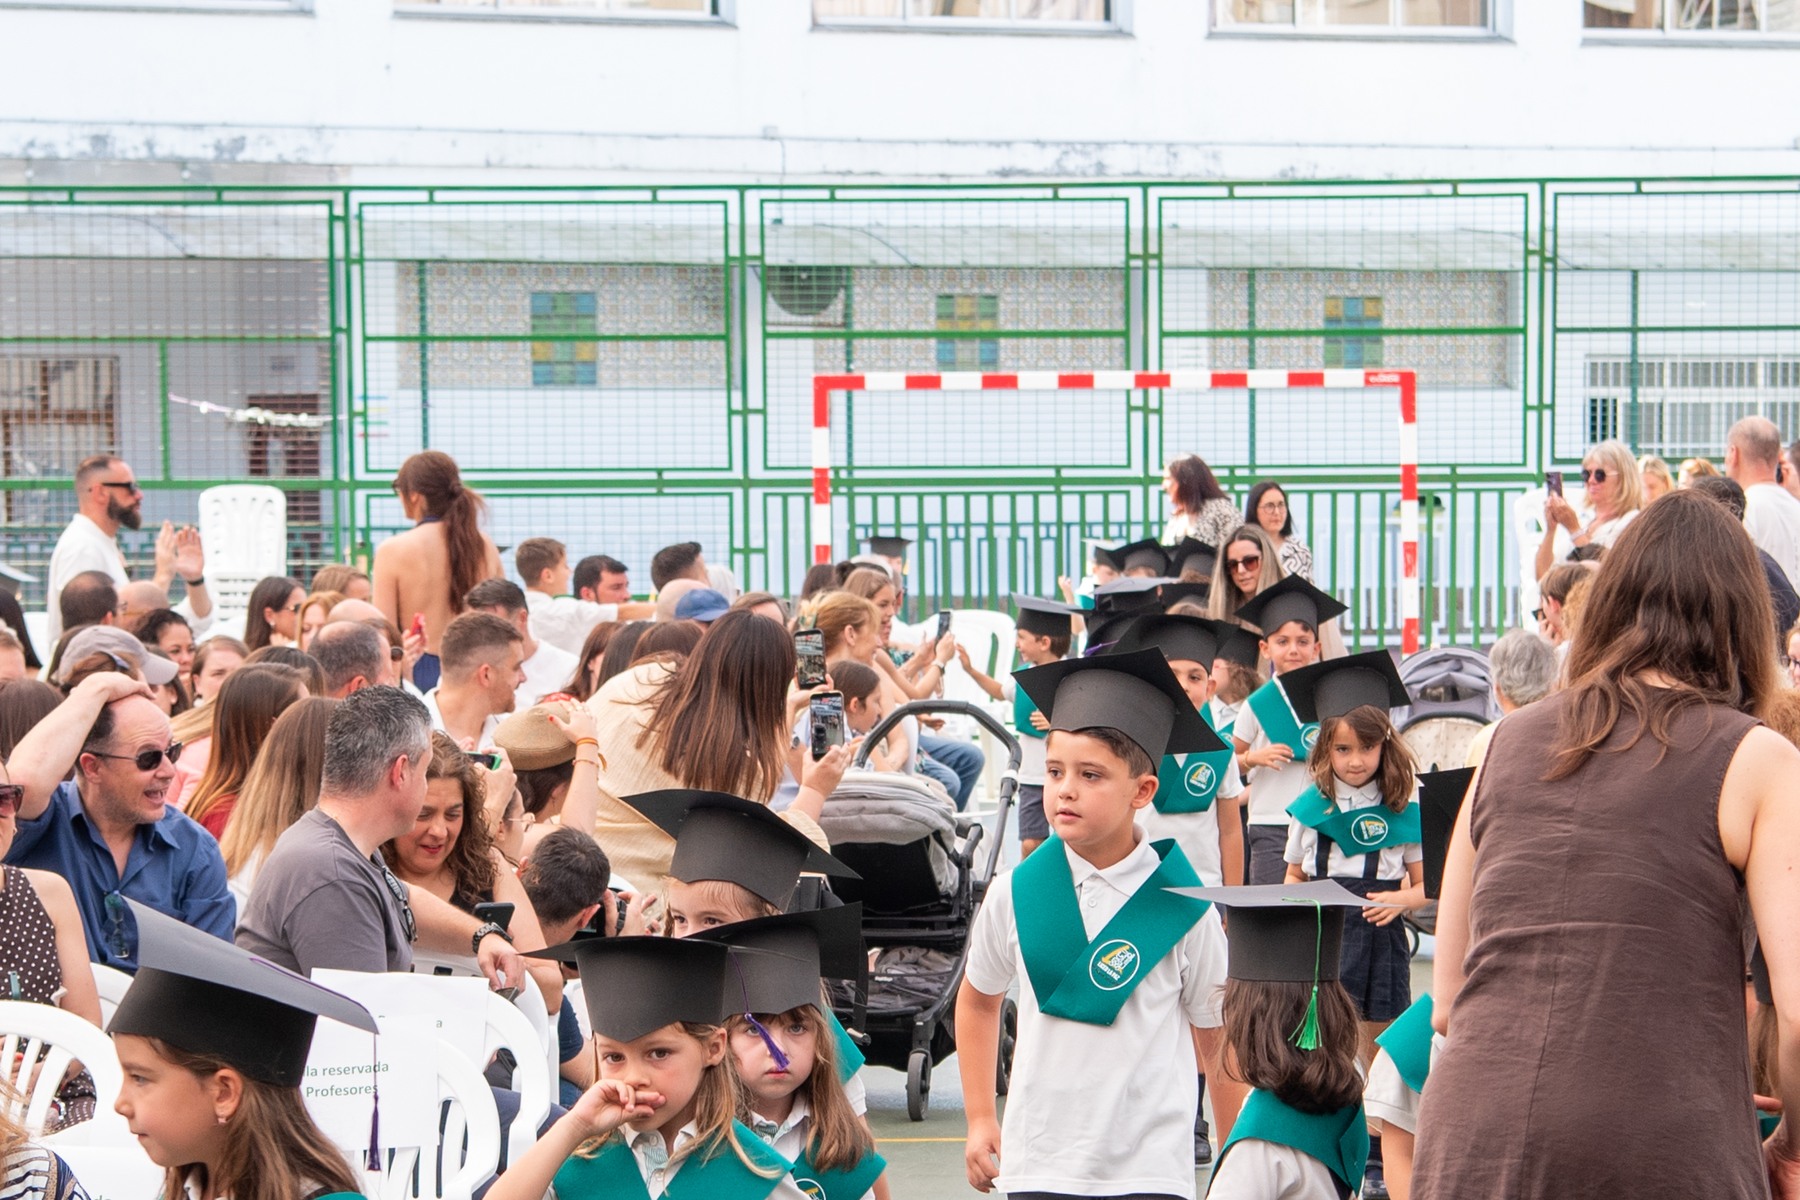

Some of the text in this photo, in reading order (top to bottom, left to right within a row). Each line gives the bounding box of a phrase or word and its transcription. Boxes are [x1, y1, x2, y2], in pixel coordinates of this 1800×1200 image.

[303, 1061, 389, 1077] la reservada
[306, 1085, 378, 1098] Profesores
